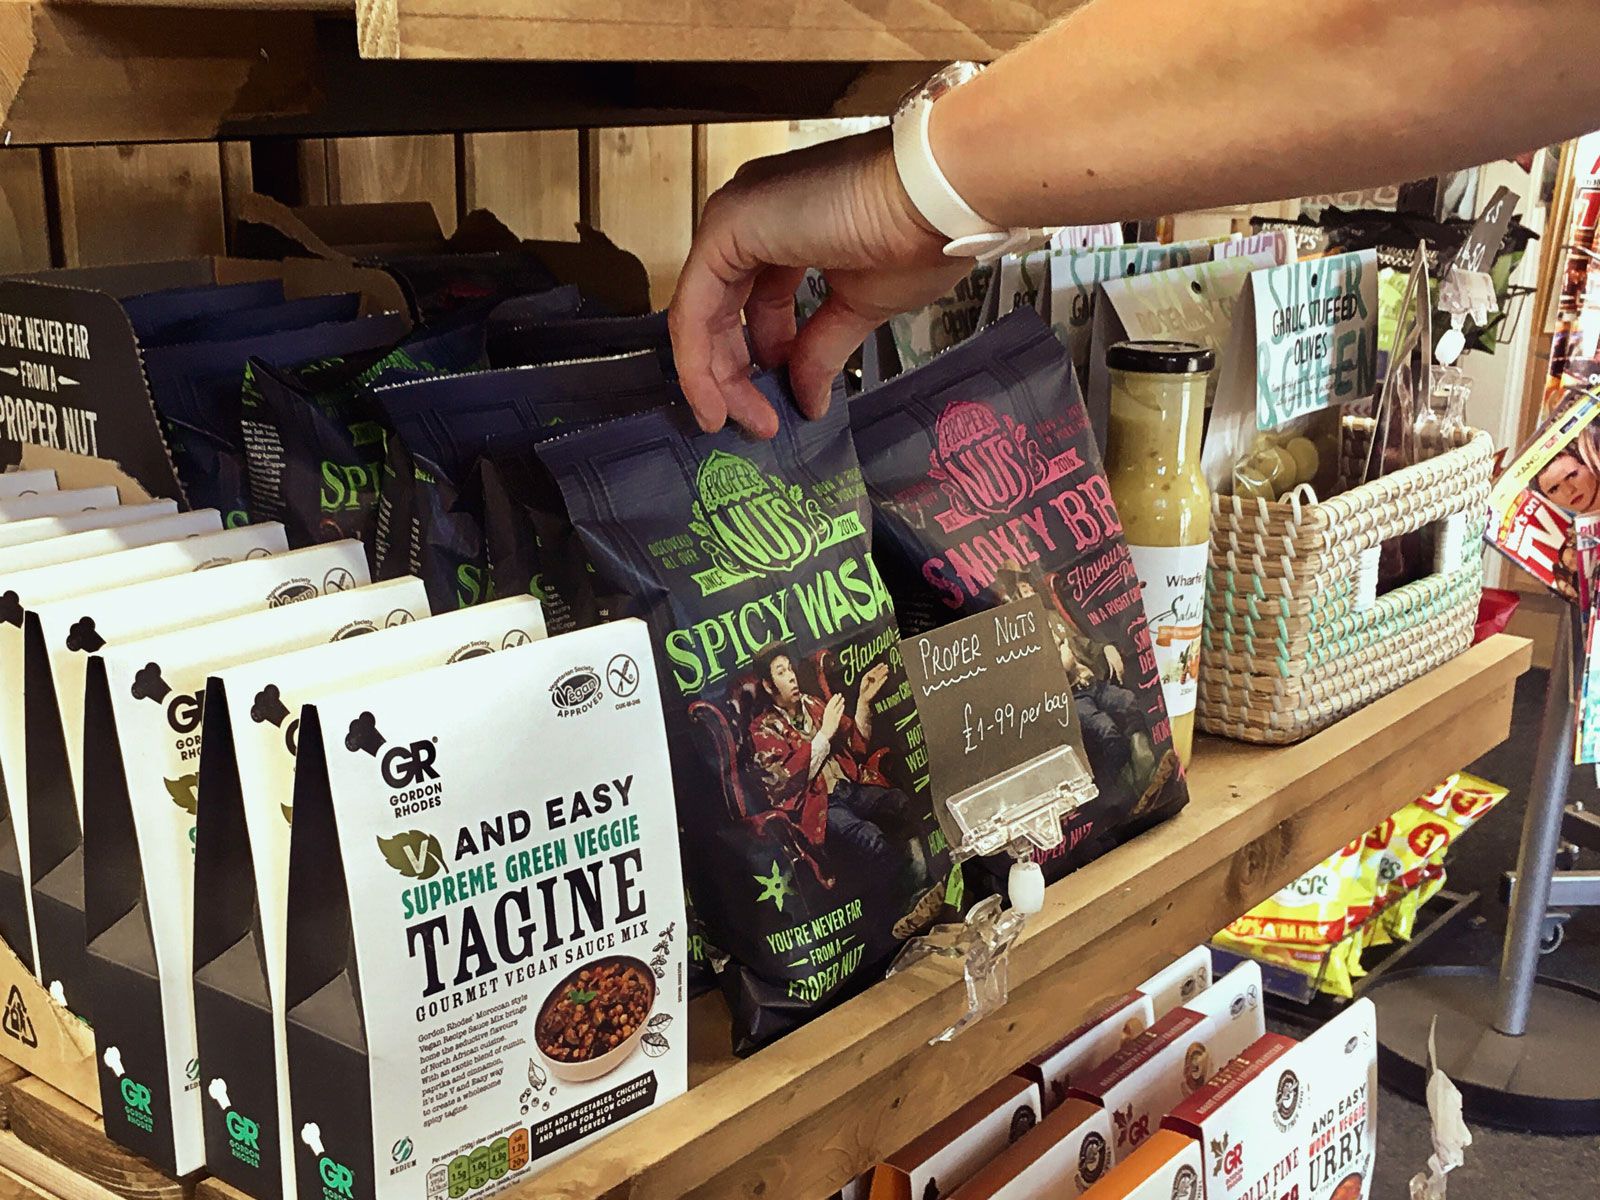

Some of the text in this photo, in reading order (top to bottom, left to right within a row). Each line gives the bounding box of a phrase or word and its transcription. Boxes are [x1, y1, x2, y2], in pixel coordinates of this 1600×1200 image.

[1267, 252, 1368, 345] SILVER
[25, 316, 65, 356] NEVER
[66, 322, 91, 360] FAR
[1272, 303, 1306, 338] GARLIC
[1294, 331, 1327, 366] OLIVES
[19, 360, 58, 393] FROM A
[1281, 329, 1375, 418] GREEN
[0, 395, 98, 457] PROPER NUT
[943, 408, 992, 448] PROPER
[704, 463, 760, 500] PROPER
[946, 435, 1023, 507] NUTS
[1053, 455, 1076, 474] 2016
[1523, 496, 1540, 516] on
[711, 493, 810, 565] NUTS
[837, 516, 858, 537] 2016
[1517, 504, 1566, 573] TV
[922, 507, 1057, 609] SMOKEY
[291, 577, 311, 585] Society
[1087, 610, 1101, 626] IN
[1099, 607, 1107, 620] A
[1105, 592, 1130, 616] RIGHT
[664, 588, 797, 697] SPICY
[918, 632, 982, 680] PROPER
[548, 665, 595, 692] Vegetarian Society
[554, 679, 600, 708] Vegan
[167, 689, 206, 734] G
[557, 691, 604, 718] APPROVED
[1018, 700, 1041, 739] per
[1044, 691, 1069, 728] bag
[381, 738, 441, 789] GR
[389, 782, 442, 808] GORDON
[394, 796, 442, 819] RHODES
[402, 774, 634, 875] V AND EASY
[401, 814, 641, 920] SUPREME GREEN VEGGIE
[405, 847, 648, 998] TAGINE
[766, 898, 863, 954] YOU'RE NEVER FAR
[415, 919, 649, 1022] GOURMET VEGAN SAUCE MIX
[809, 936, 842, 967] FROM A
[840, 942, 866, 980] NUT
[418, 993, 528, 1043] Gordon Rhodes' Moroccan style
[418, 1004, 527, 1053] Vegan Recipe Sauce Mix brings
[420, 1019, 518, 1064] home the seductive flavours
[420, 1035, 507, 1075] of North African cuisine.
[421, 1072, 439, 1085] With
[440, 1068, 450, 1077] an
[451, 1059, 473, 1072] exotic
[474, 1049, 494, 1064] blend
[494, 1044, 502, 1055] of
[422, 1078, 451, 1097] paprika
[451, 1072, 466, 1085] and
[435, 1091, 448, 1102] the
[449, 1087, 456, 1095] V
[456, 1081, 470, 1093] and
[471, 1073, 489, 1088] Easy
[490, 1067, 504, 1079] way
[120, 1077, 153, 1116] GR
[124, 1105, 154, 1125] GORDON
[422, 1107, 431, 1117] to
[432, 1099, 456, 1113] create
[462, 1078, 502, 1100] wholesome
[535, 1122, 554, 1135] JUST
[554, 1115, 569, 1127] ADD
[615, 1075, 652, 1098] CHICKPEAS
[539, 1087, 649, 1143] AND WATER FOR SLOW COOKING.
[1311, 1083, 1367, 1138] AND EASY
[226, 1110, 260, 1151] GR
[423, 1112, 443, 1128] spicy
[579, 1113, 612, 1134] SERVES 4
[229, 1139, 261, 1161] GORDON
[389, 1159, 418, 1176] MEDIUM
[441, 1148, 459, 1162] serving
[1223, 1142, 1244, 1176] GR
[1273, 1146, 1299, 1187] FINE
[319, 1156, 353, 1199] GR
